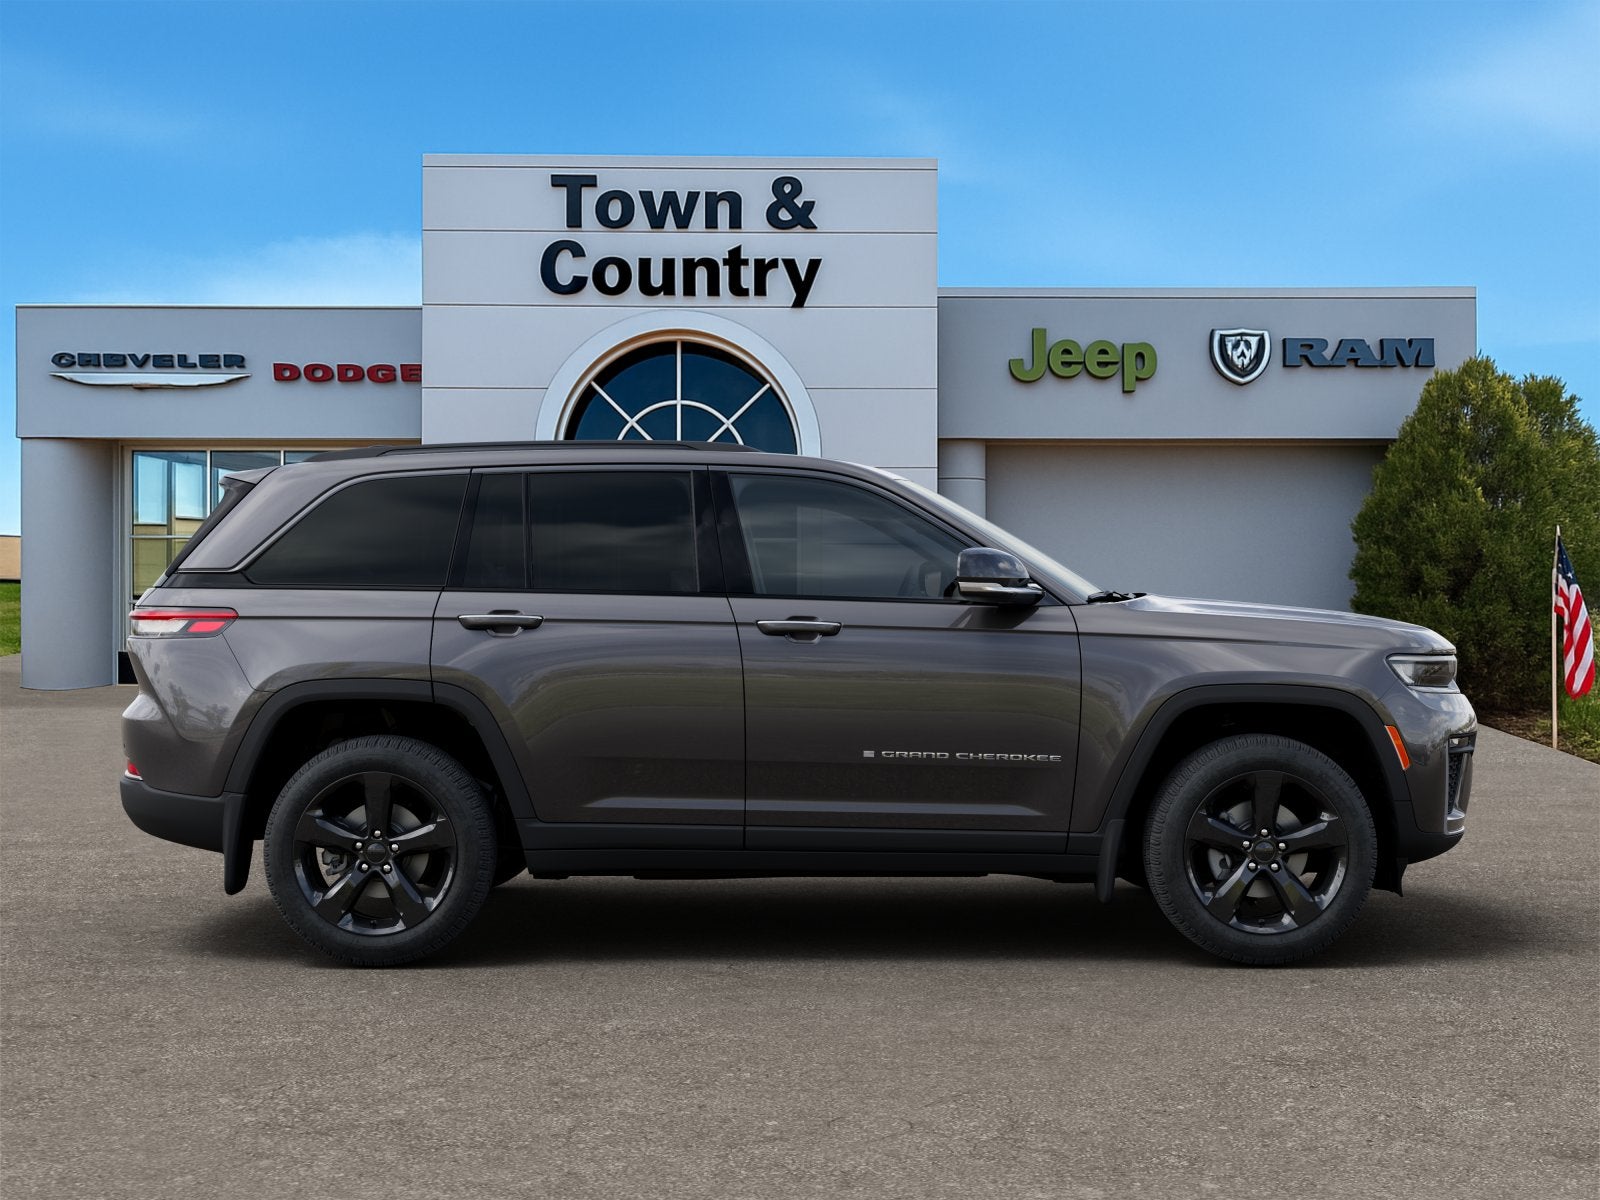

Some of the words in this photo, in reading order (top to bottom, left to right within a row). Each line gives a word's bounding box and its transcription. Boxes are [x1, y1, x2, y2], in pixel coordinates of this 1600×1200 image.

[550, 174, 742, 230] Town
[766, 176, 817, 230] &
[540, 239, 822, 309] Country
[272, 362, 422, 383] DODGE
[1009, 328, 1158, 393] Jeep
[1283, 337, 1435, 368] RAM
[881, 751, 949, 759] GRAND
[955, 752, 1063, 762] CHEROKEE
